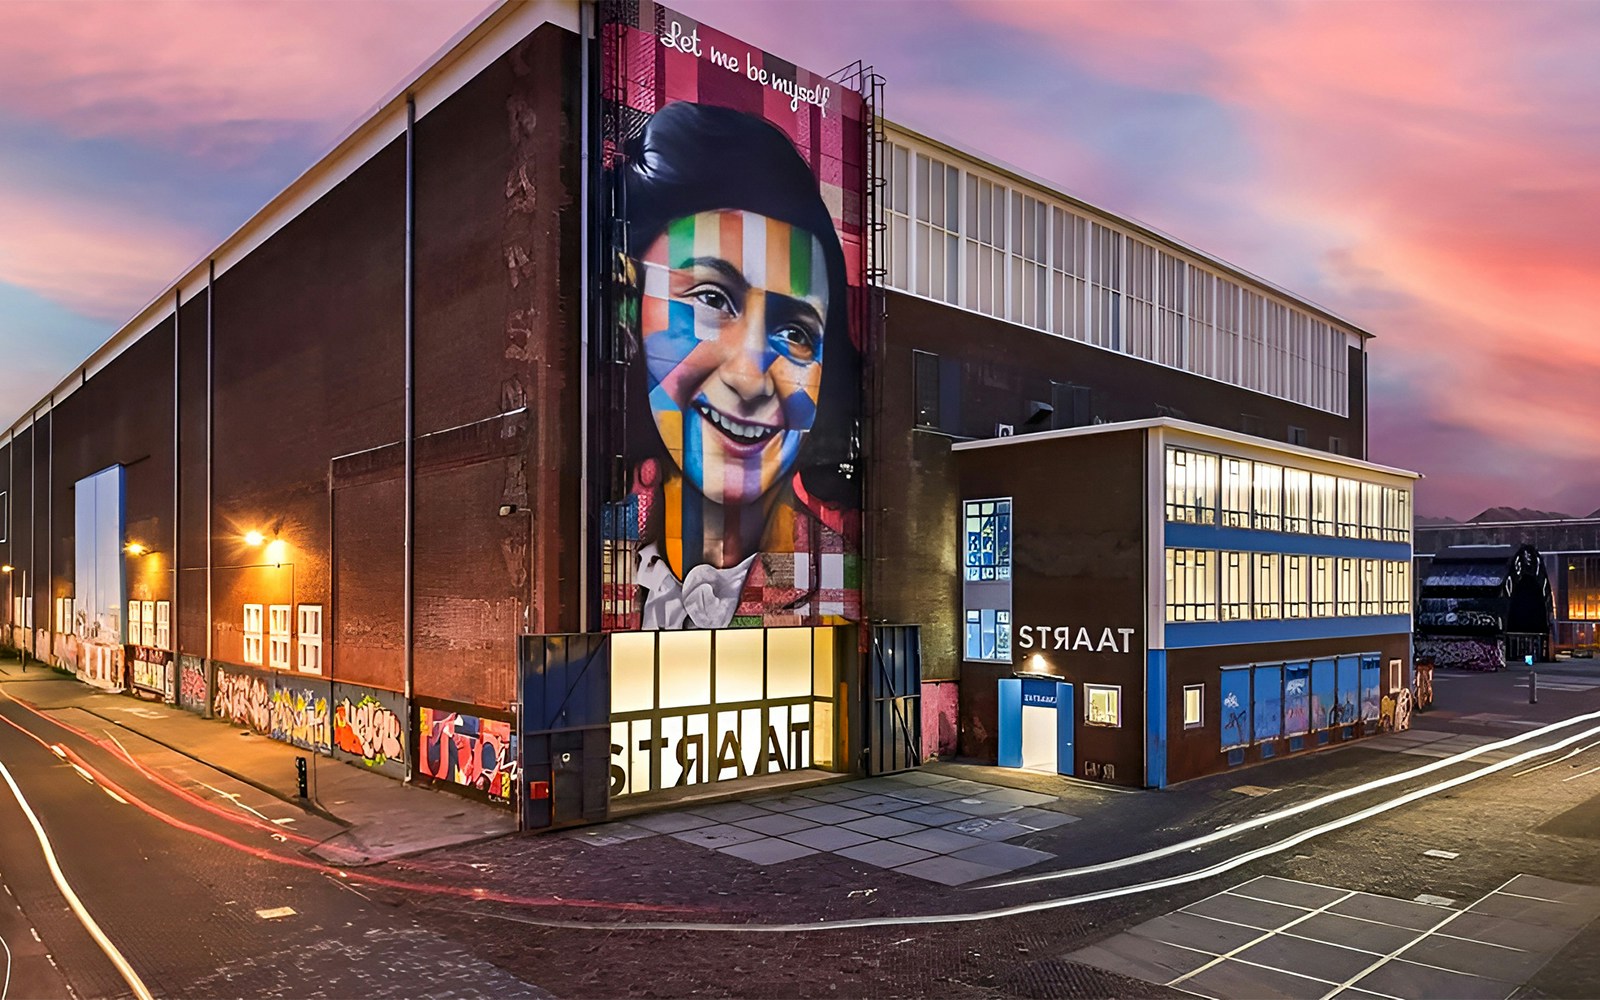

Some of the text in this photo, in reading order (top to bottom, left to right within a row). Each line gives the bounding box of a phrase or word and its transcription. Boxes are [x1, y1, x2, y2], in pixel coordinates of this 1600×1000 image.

[660, 21, 830, 118] Let me be myself
[1018, 625, 1135, 653] STRAAT
